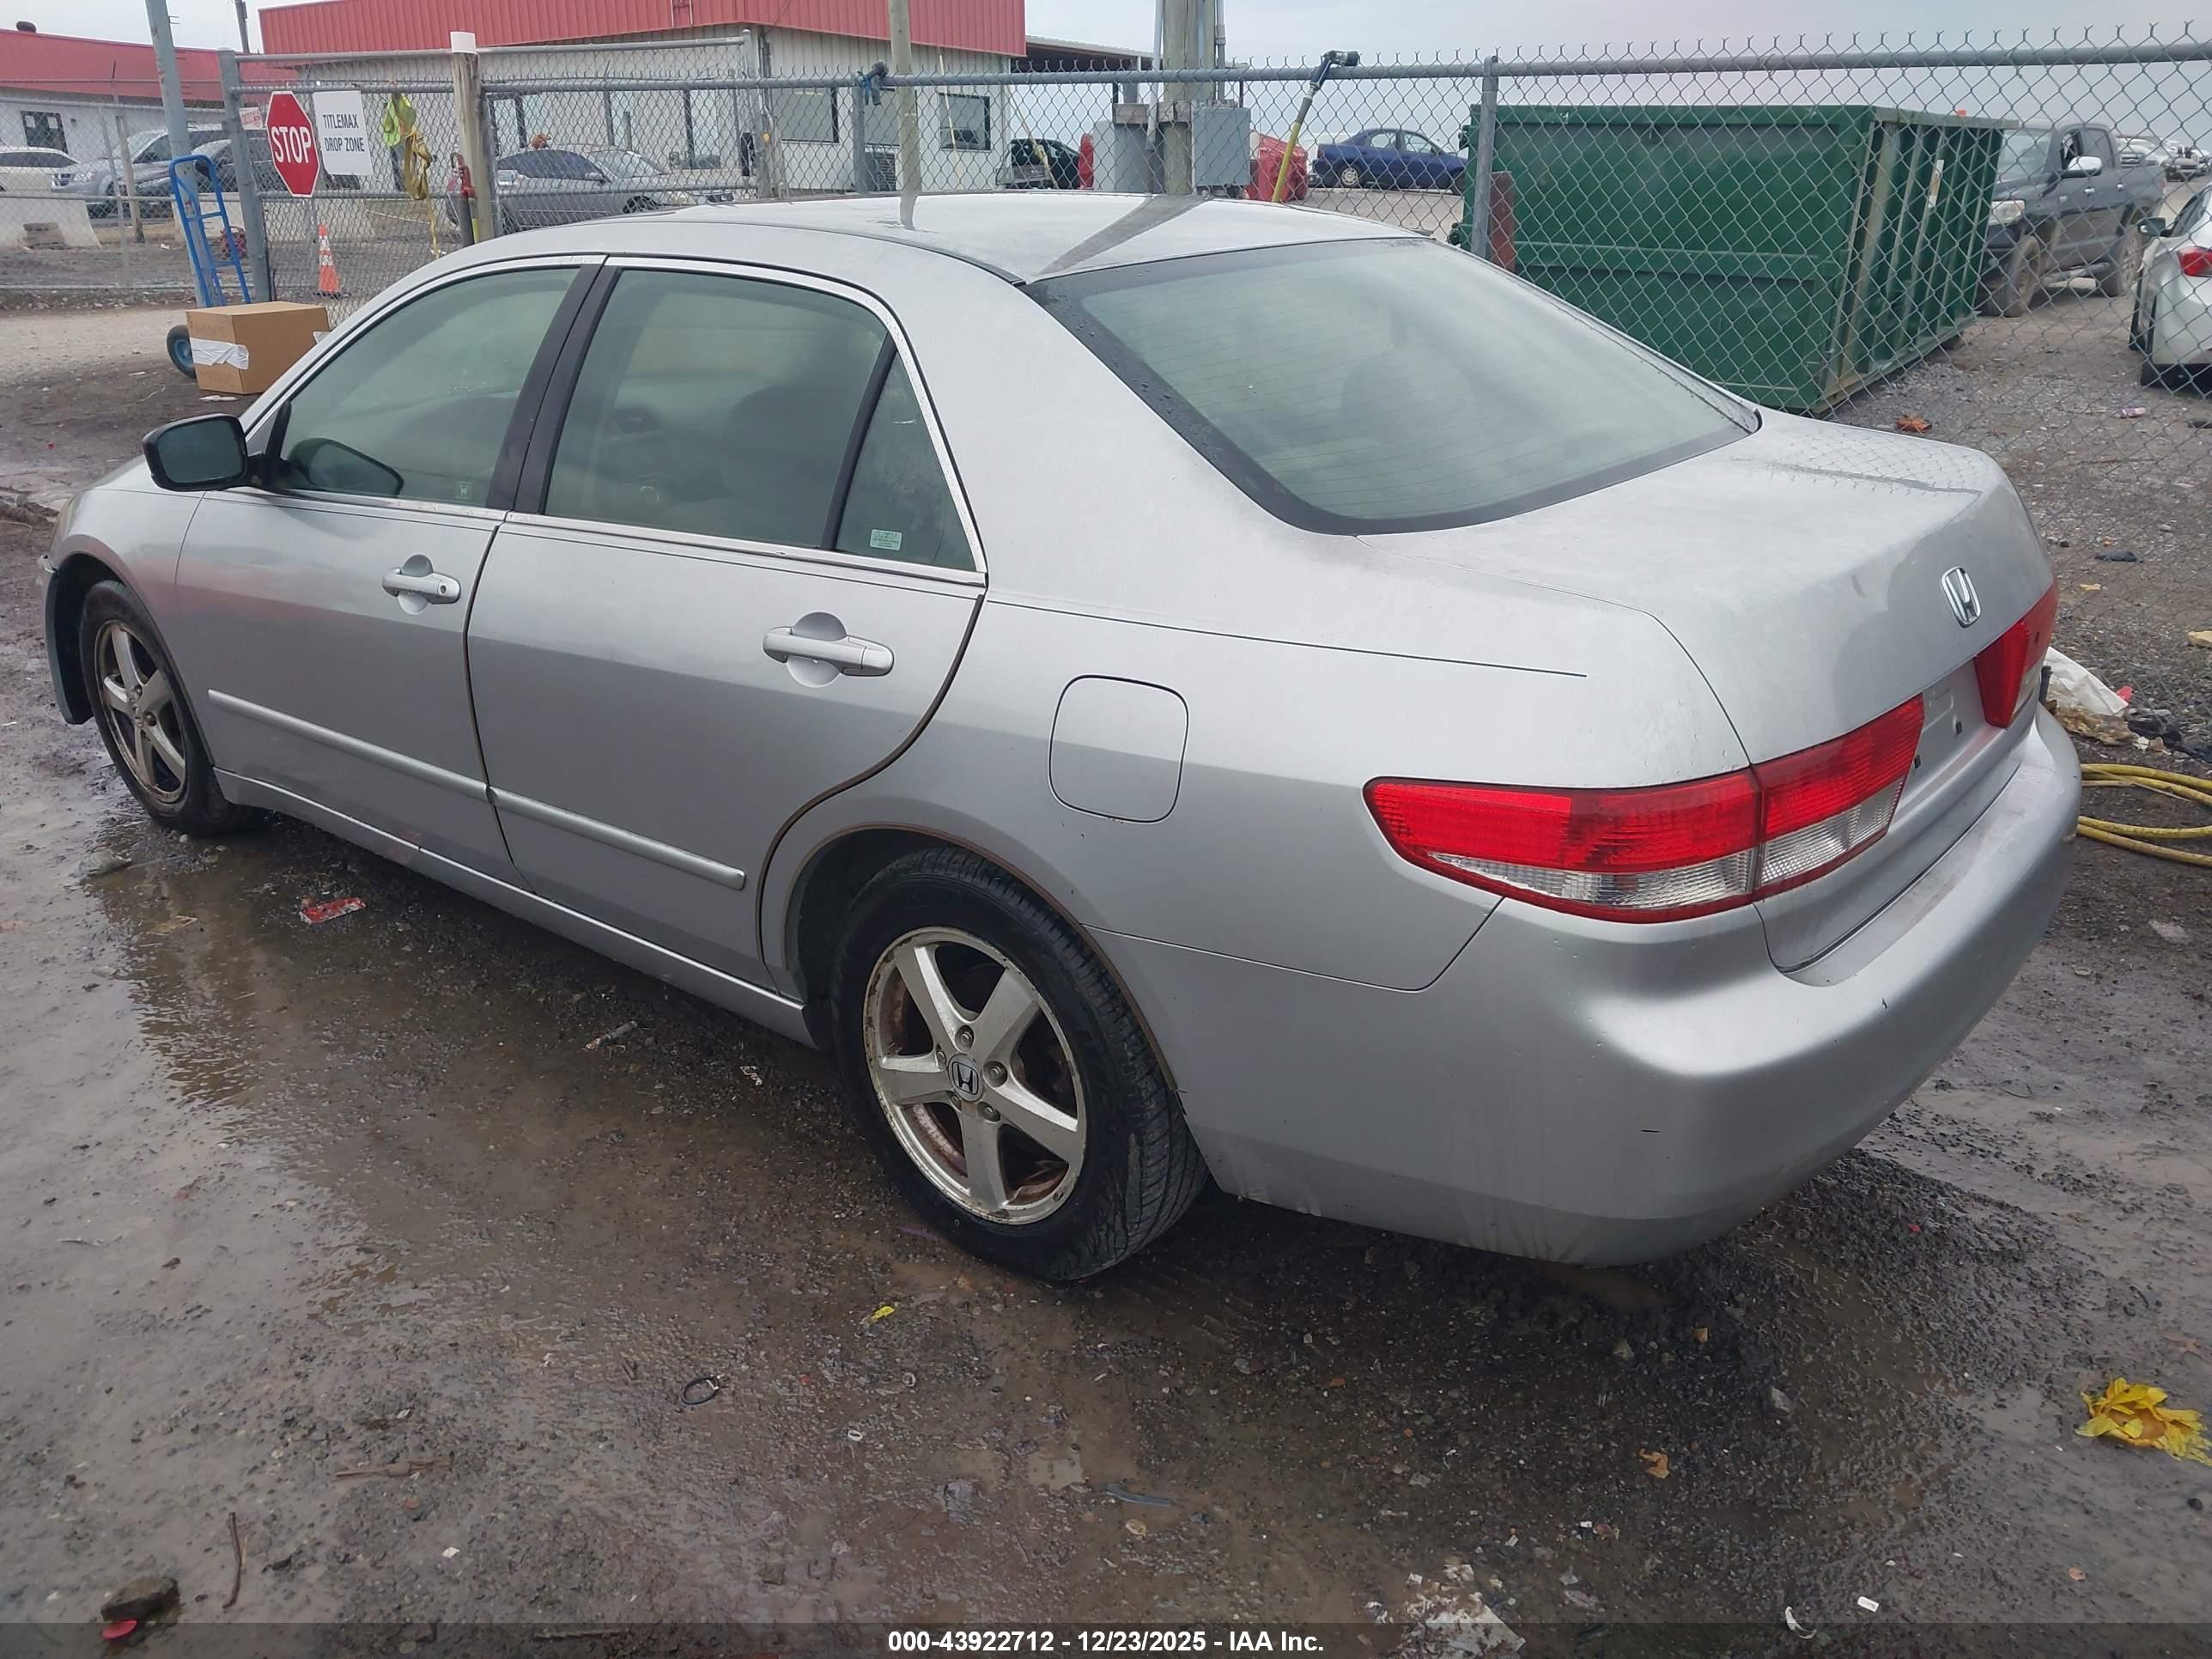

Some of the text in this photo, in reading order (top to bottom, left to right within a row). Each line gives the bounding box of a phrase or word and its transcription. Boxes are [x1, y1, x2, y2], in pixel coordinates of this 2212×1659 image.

[322, 113, 359, 129] TITLEMAX
[270, 125, 312, 164] STOP
[324, 137, 366, 152] DROP ZONE
